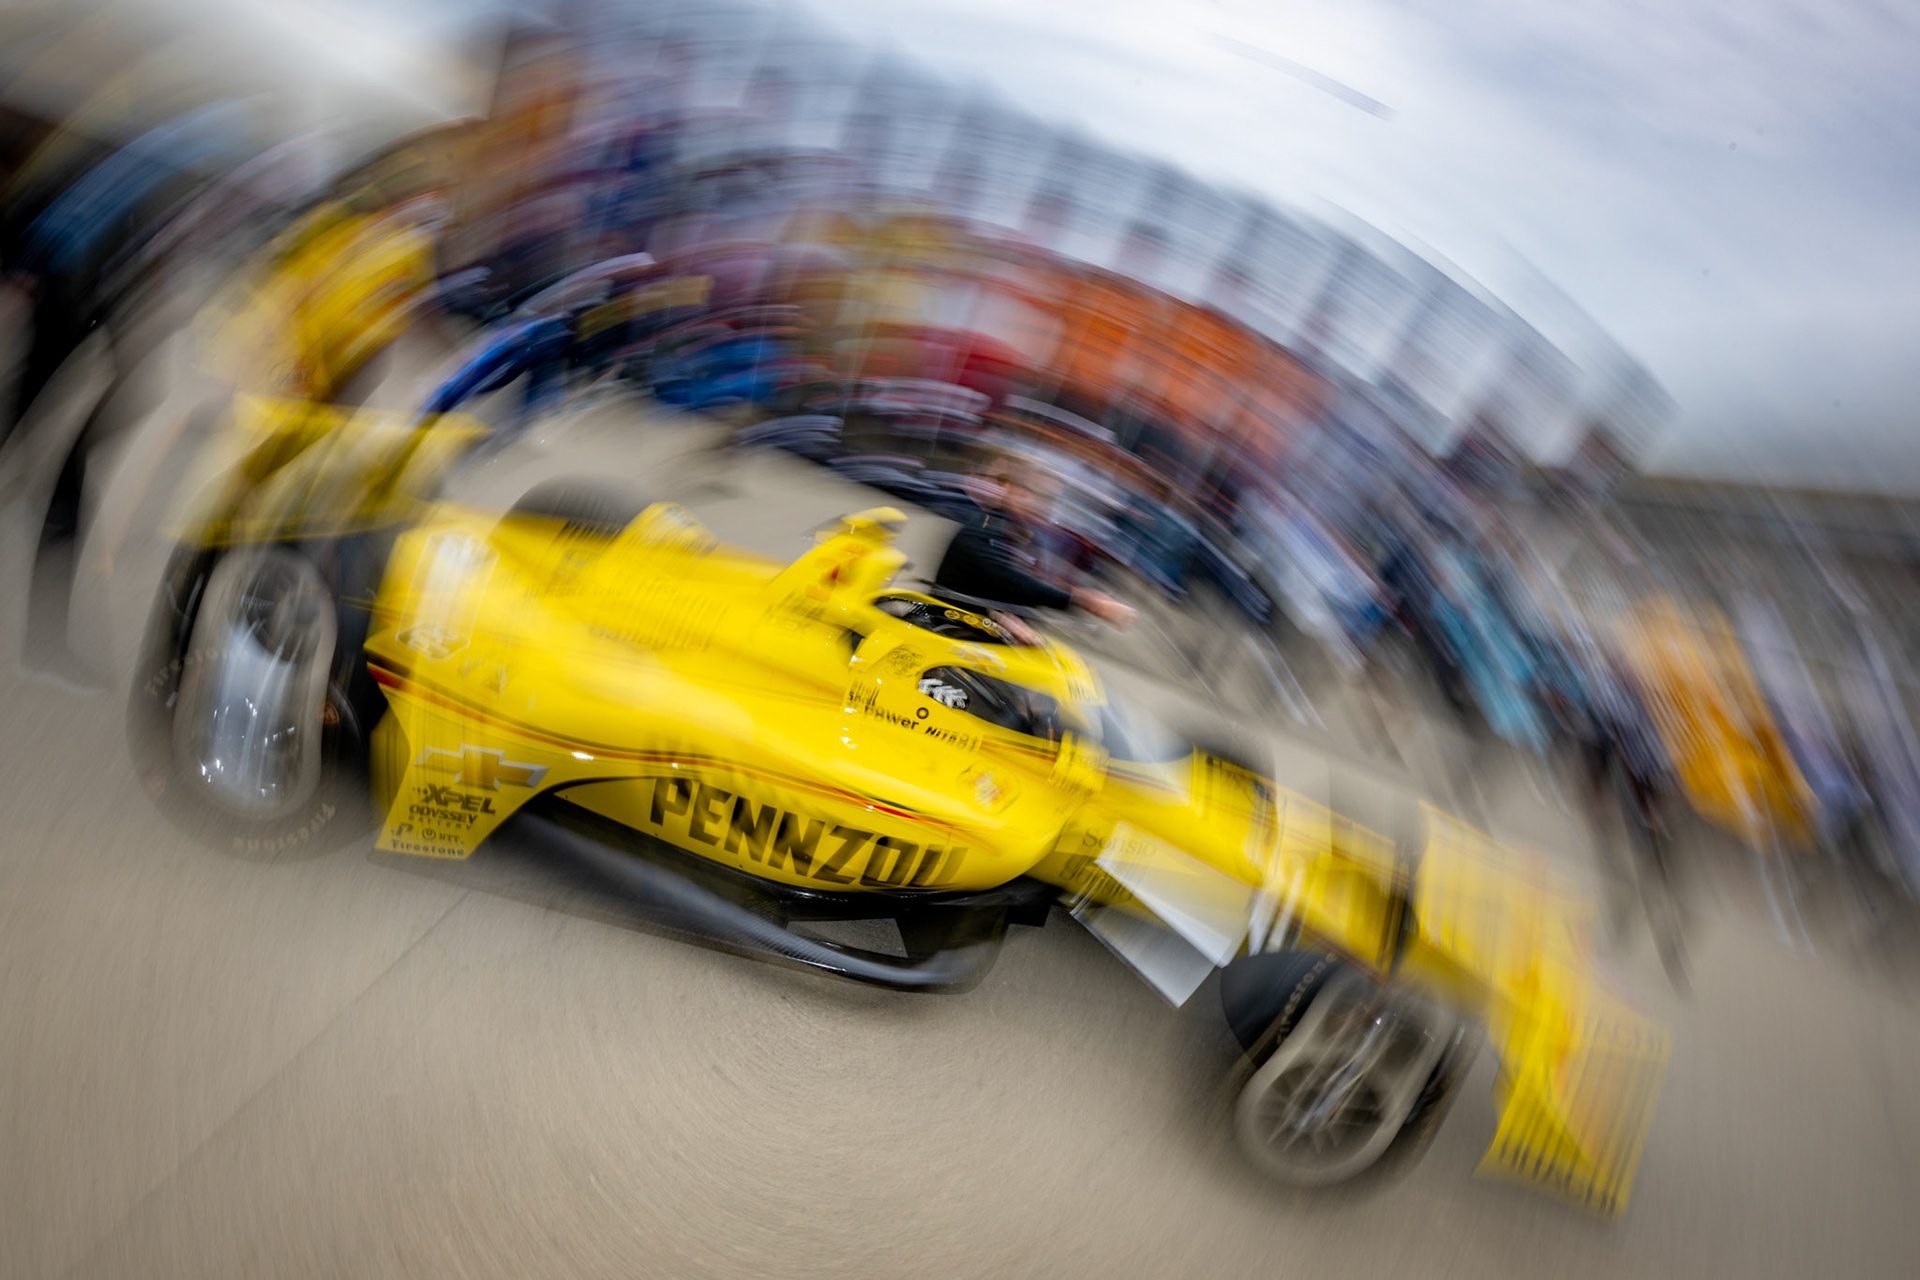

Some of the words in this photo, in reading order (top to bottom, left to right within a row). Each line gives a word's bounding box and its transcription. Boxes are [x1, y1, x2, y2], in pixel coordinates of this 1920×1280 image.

[423, 783, 496, 815] XPEL
[409, 804, 478, 824] ODYSSEY
[392, 839, 464, 856] Firestone
[1082, 827, 1156, 857] Sonsio
